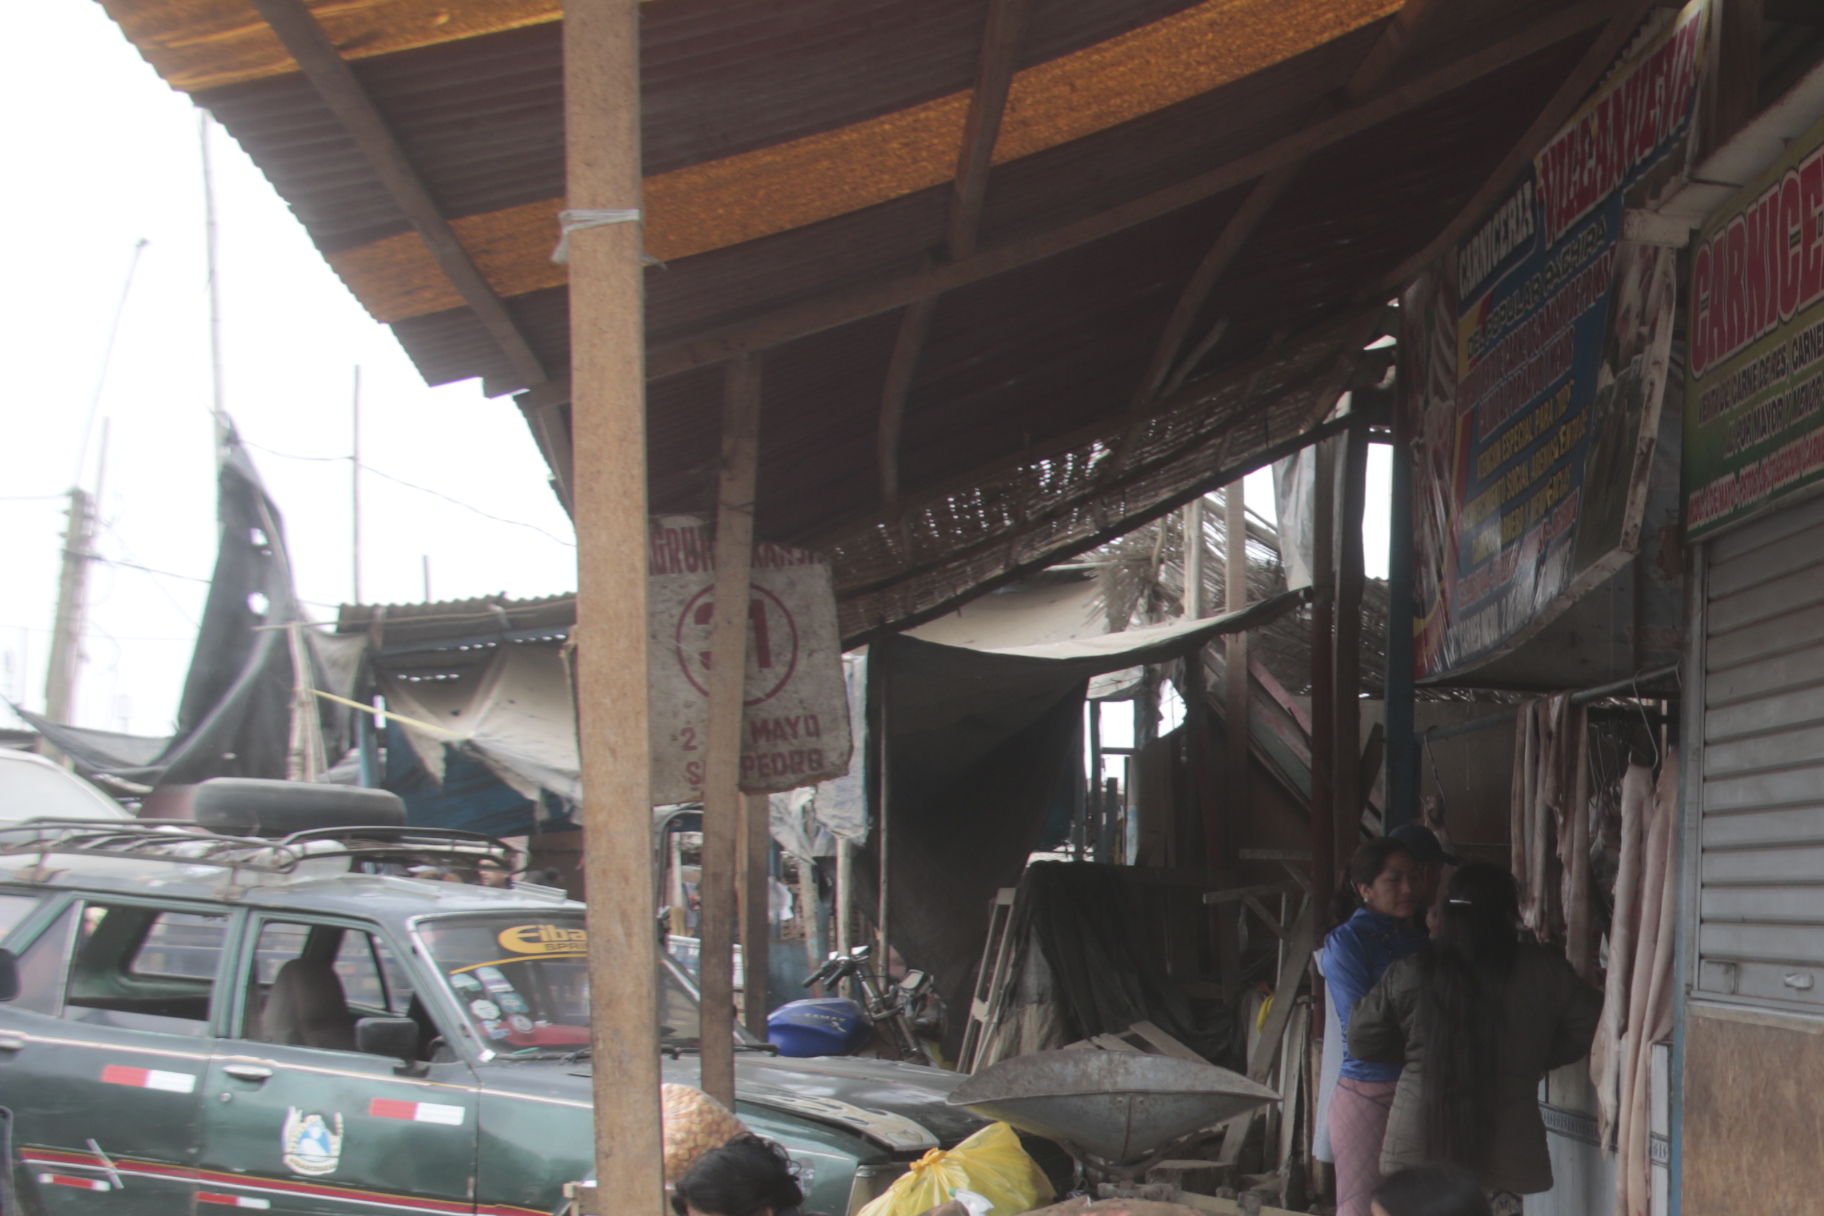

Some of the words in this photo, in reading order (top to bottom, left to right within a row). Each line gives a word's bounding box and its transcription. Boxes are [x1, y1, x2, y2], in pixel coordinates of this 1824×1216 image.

[1459, 181, 1535, 301] CARNICERIA
[1486, 272, 1542, 345] POPULAR
[1731, 361, 1757, 407] CARNE
[1759, 354, 1770, 387] DE
[1771, 341, 1789, 383] RES,
[1753, 396, 1784, 444] MAYOR
[680, 726, 699, 752] 2
[750, 713, 822, 745] MAYO
